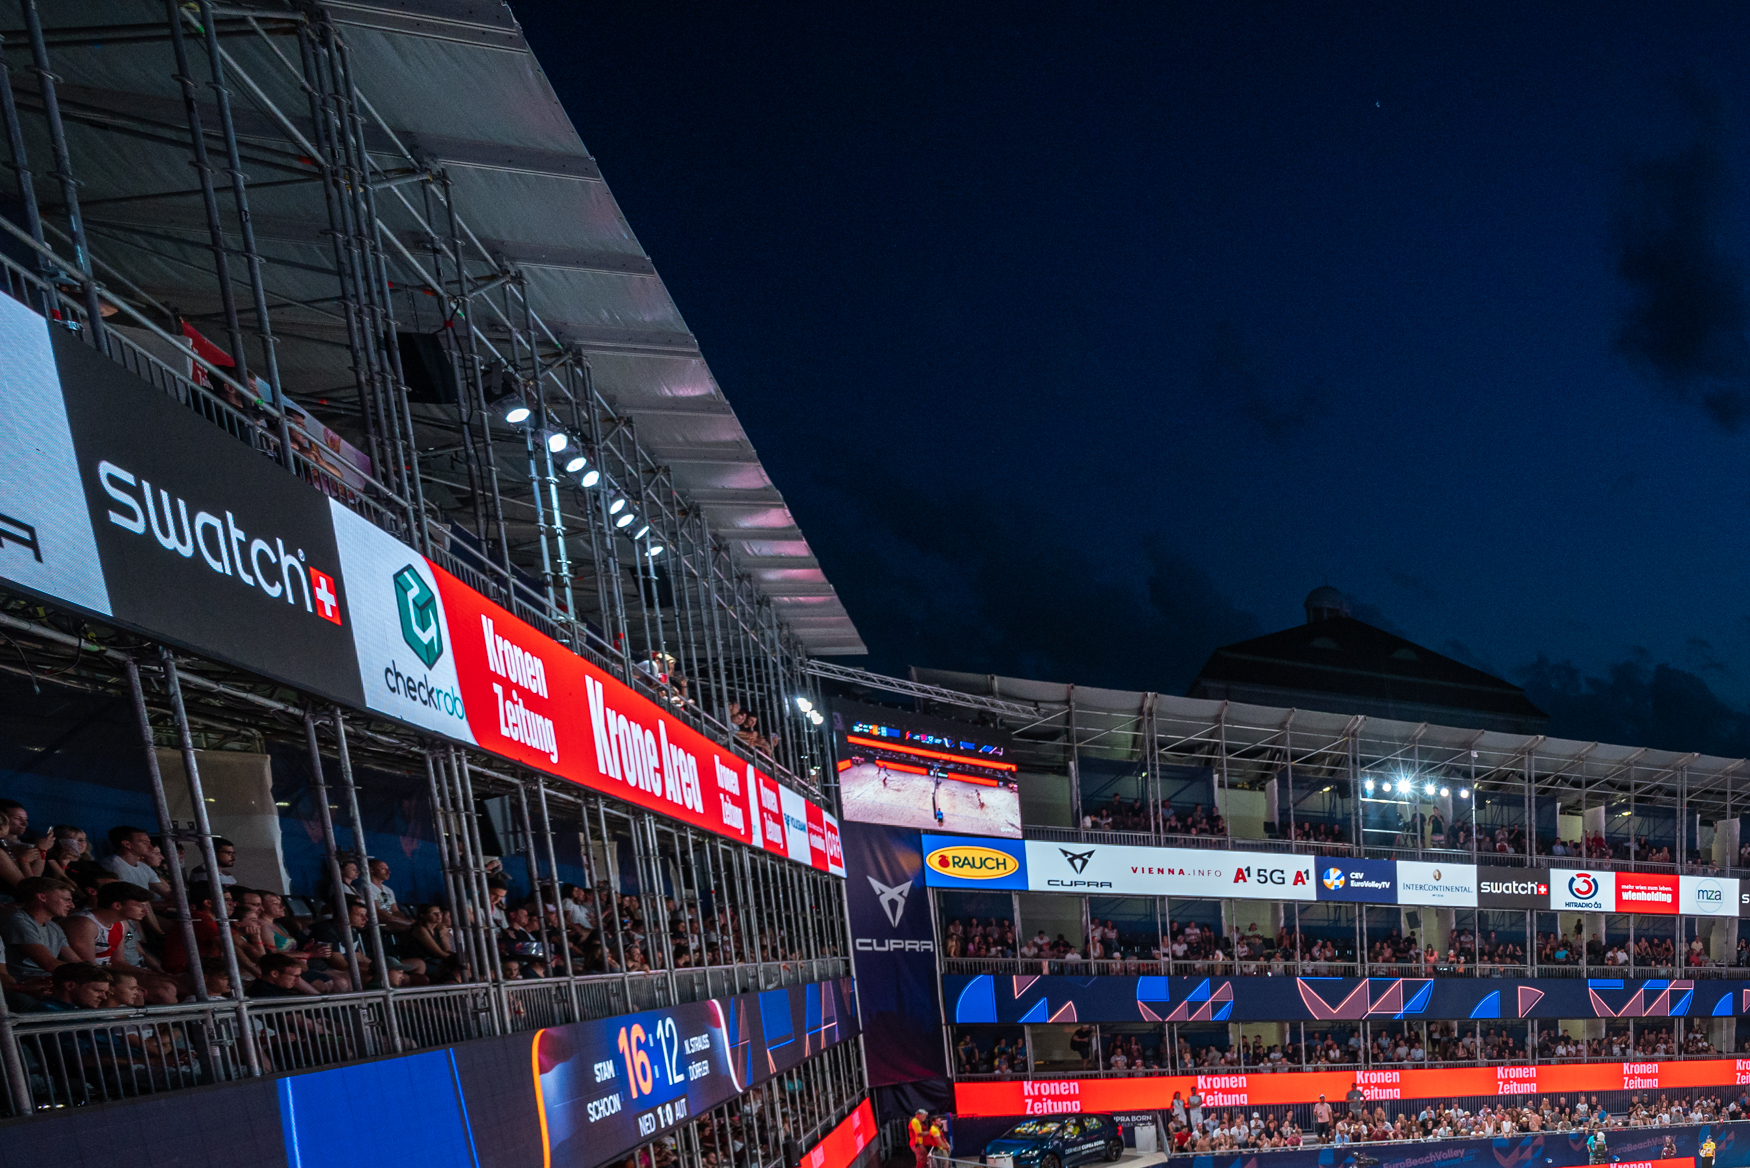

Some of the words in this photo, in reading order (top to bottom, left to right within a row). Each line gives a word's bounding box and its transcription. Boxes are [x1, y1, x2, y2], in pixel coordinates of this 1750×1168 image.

[98, 459, 314, 614] swatch
[480, 613, 549, 699] Kronen
[492, 681, 559, 764] Zeitung
[584, 674, 663, 798] Krone
[951, 855, 1007, 871] RAUCH
[1131, 866, 1222, 878] VIENNA.INFO
[1233, 866, 1251, 884] A1
[1256, 869, 1286, 885] 5G
[1292, 868, 1310, 886] A1
[1349, 871, 1364, 880] CEV
[1047, 879, 1113, 889] CUPRA
[1349, 880, 1391, 889] EuroVolleyTV
[1480, 880, 1538, 894] swatch
[1697, 888, 1722, 901] mza
[1564, 901, 1593, 909] HITRADIO
[855, 938, 934, 953] CUPRA
[593, 1059, 615, 1084] STAM
[1497, 1066, 1537, 1079] Kronen
[1622, 1062, 1659, 1075] Kronen
[1197, 1074, 1247, 1089] Kronen
[1355, 1070, 1400, 1084] Kronen
[1623, 1076, 1659, 1090] Zeitung
[1023, 1081, 1079, 1097] Kronen
[1498, 1081, 1537, 1095] Zeitung
[1025, 1096, 1081, 1115] Zeitung
[1199, 1091, 1248, 1107] Zeitung
[586, 1093, 622, 1123] SCHOON
[638, 1112, 657, 1138] NED
[674, 1097, 688, 1120] AUT
[1131, 1114, 1153, 1122] BORN
